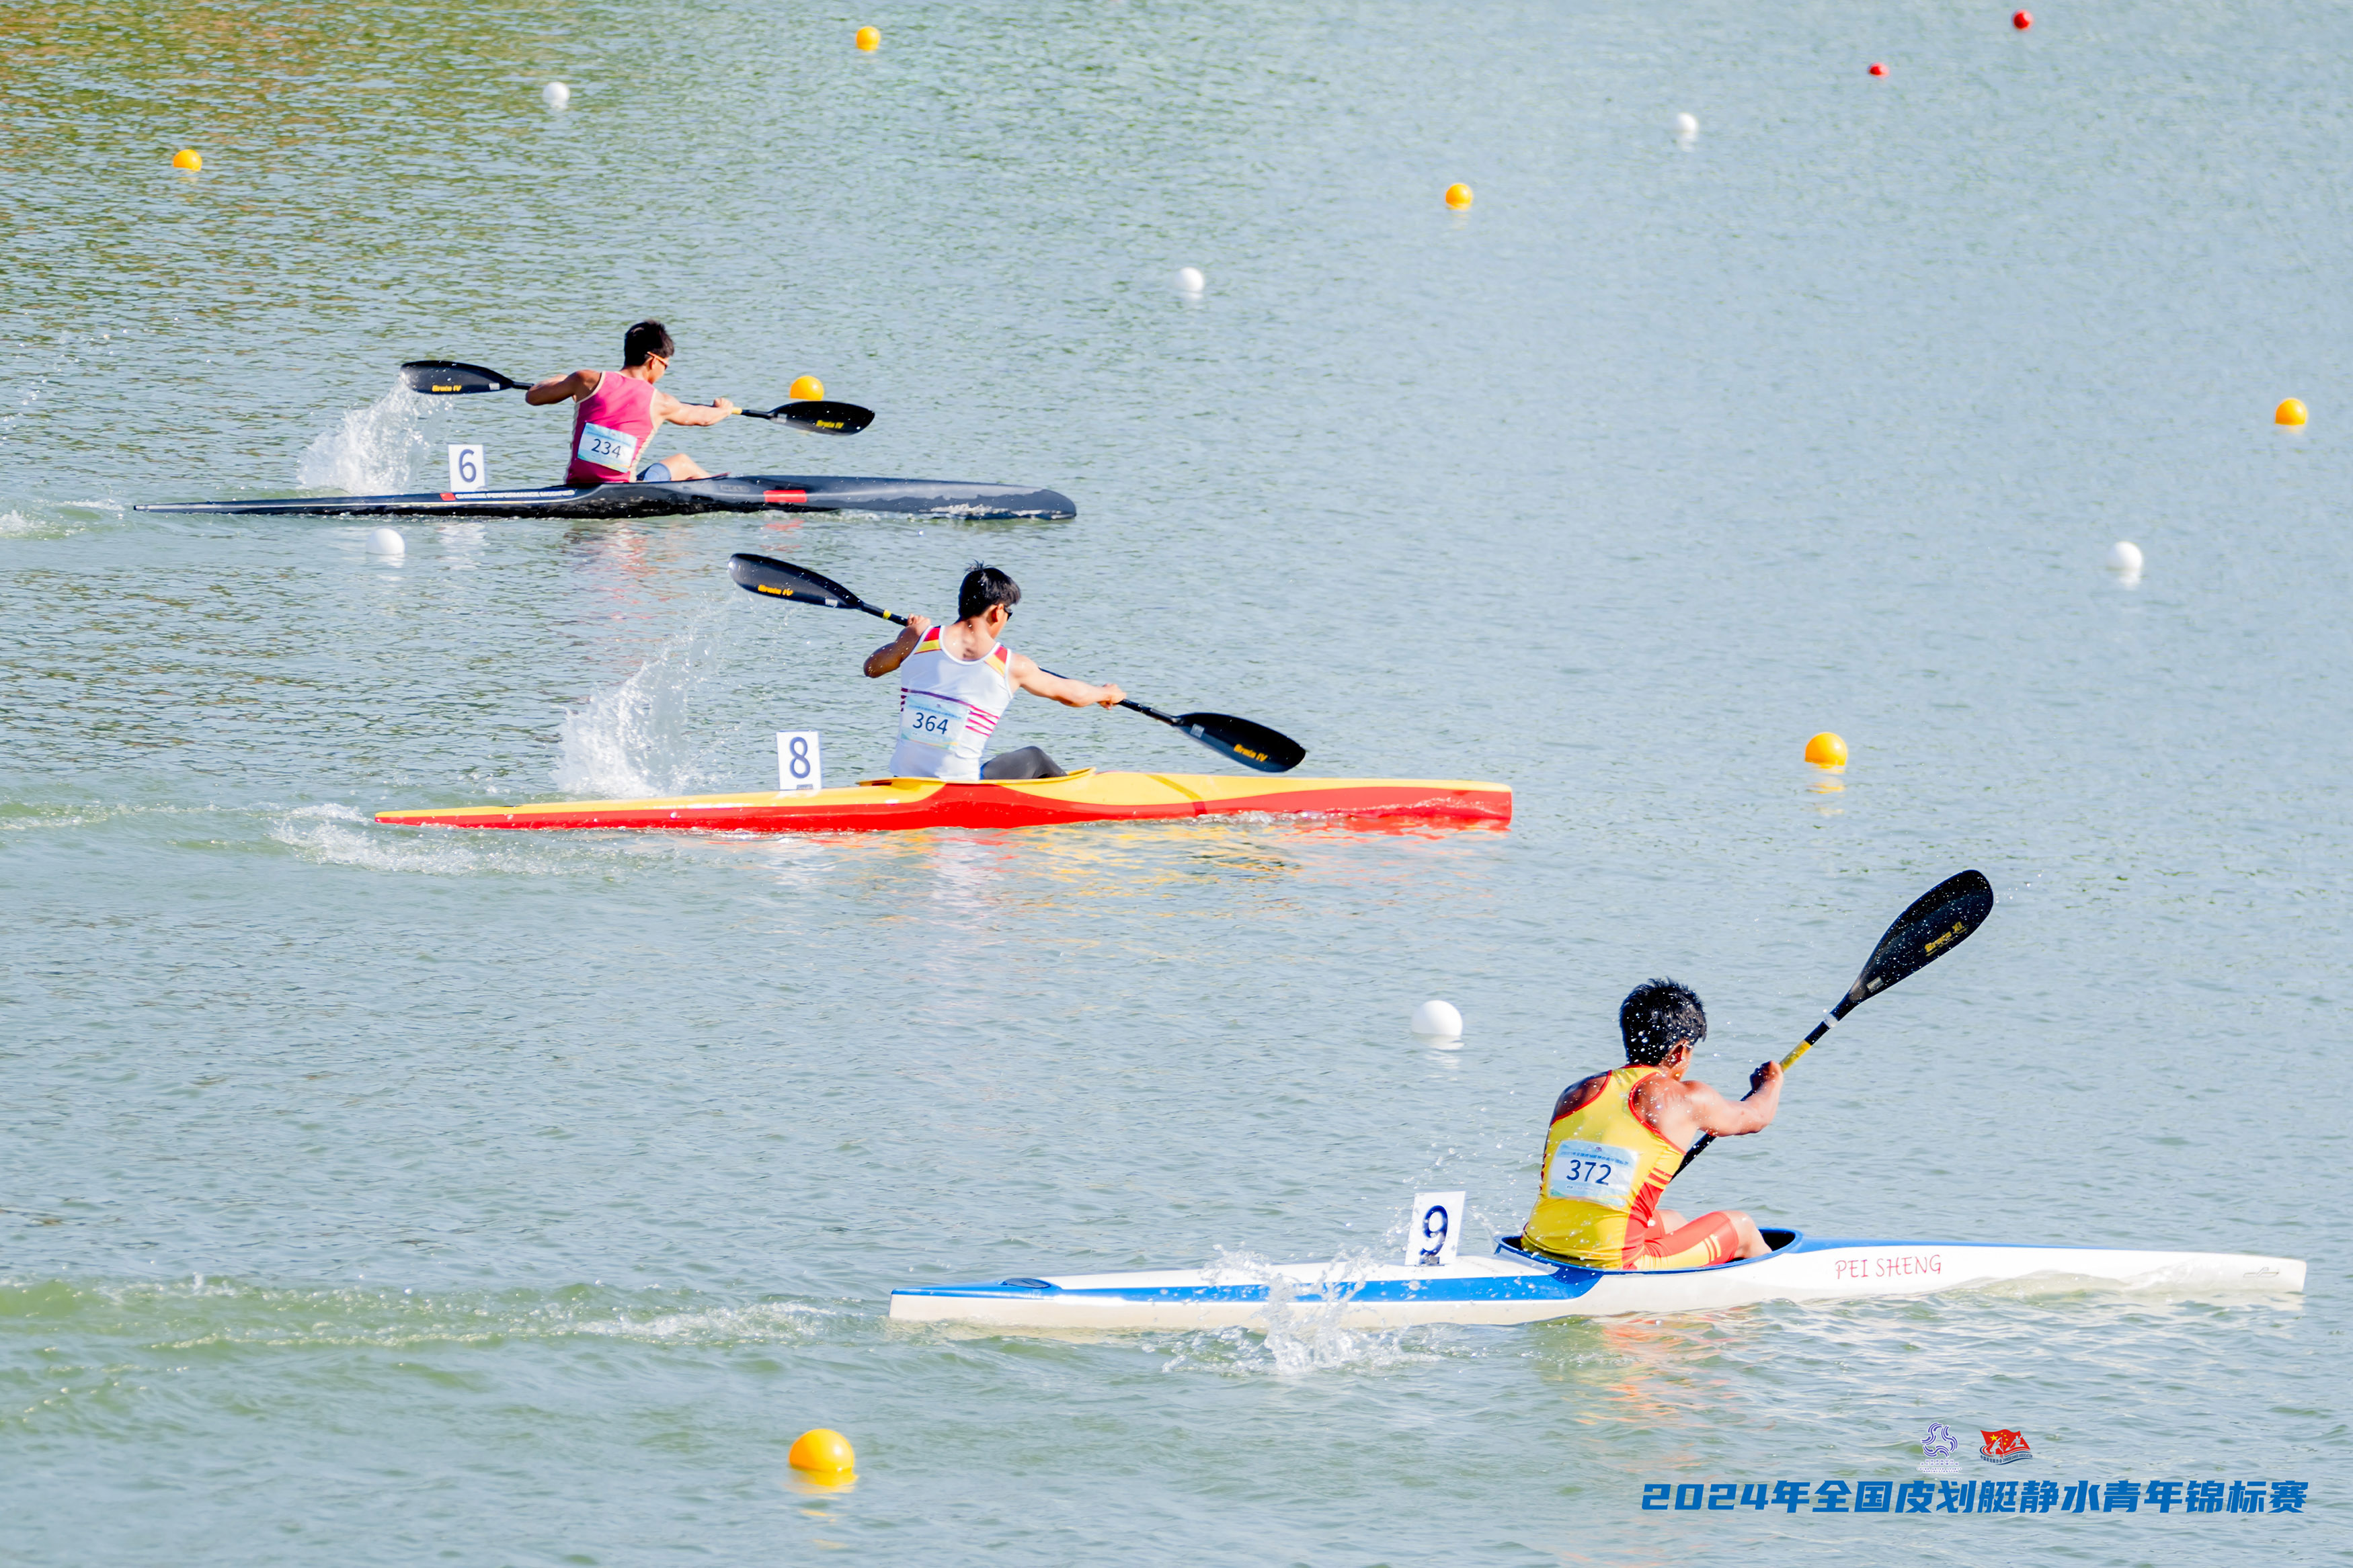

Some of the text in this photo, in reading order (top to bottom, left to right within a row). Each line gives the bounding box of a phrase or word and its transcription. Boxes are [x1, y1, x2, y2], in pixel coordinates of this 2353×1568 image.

[591, 438, 621, 458] 234
[458, 449, 477, 483] 6
[912, 712, 949, 735] 364
[789, 736, 811, 779] 8
[1566, 1159, 1611, 1186] 372
[1419, 1205, 1449, 1257] 9
[1835, 1254, 1942, 1280] PEI SHENG
